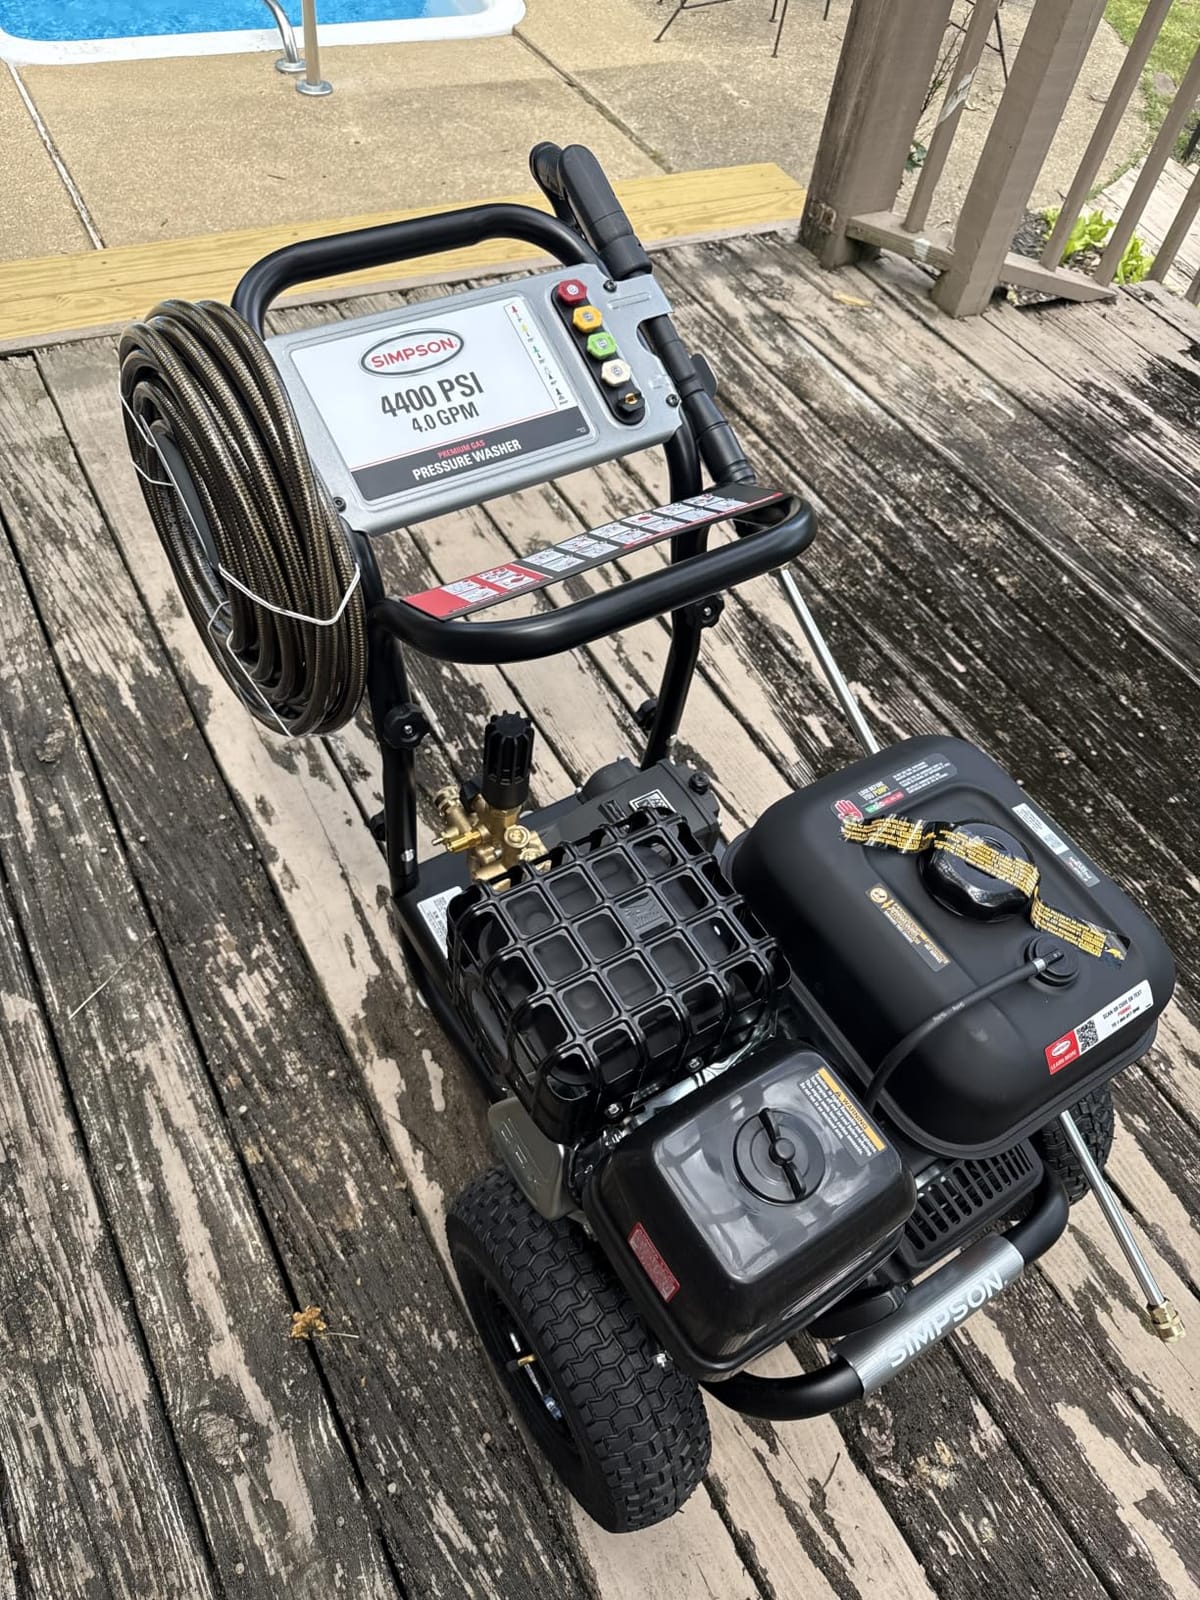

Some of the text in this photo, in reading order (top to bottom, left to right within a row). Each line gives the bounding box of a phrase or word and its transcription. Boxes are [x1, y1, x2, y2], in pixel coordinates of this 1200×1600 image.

[371, 338, 454, 367] SIMPSON
[381, 371, 483, 417] 4400 PSI
[412, 401, 479, 432] 4.0 GPM
[412, 439, 522, 480] PRESSURE WASHER
[438, 439, 486, 459] PREMIUM GAS
[842, 1097, 868, 1130] WARNING
[889, 1268, 1004, 1368] SIMPSON
